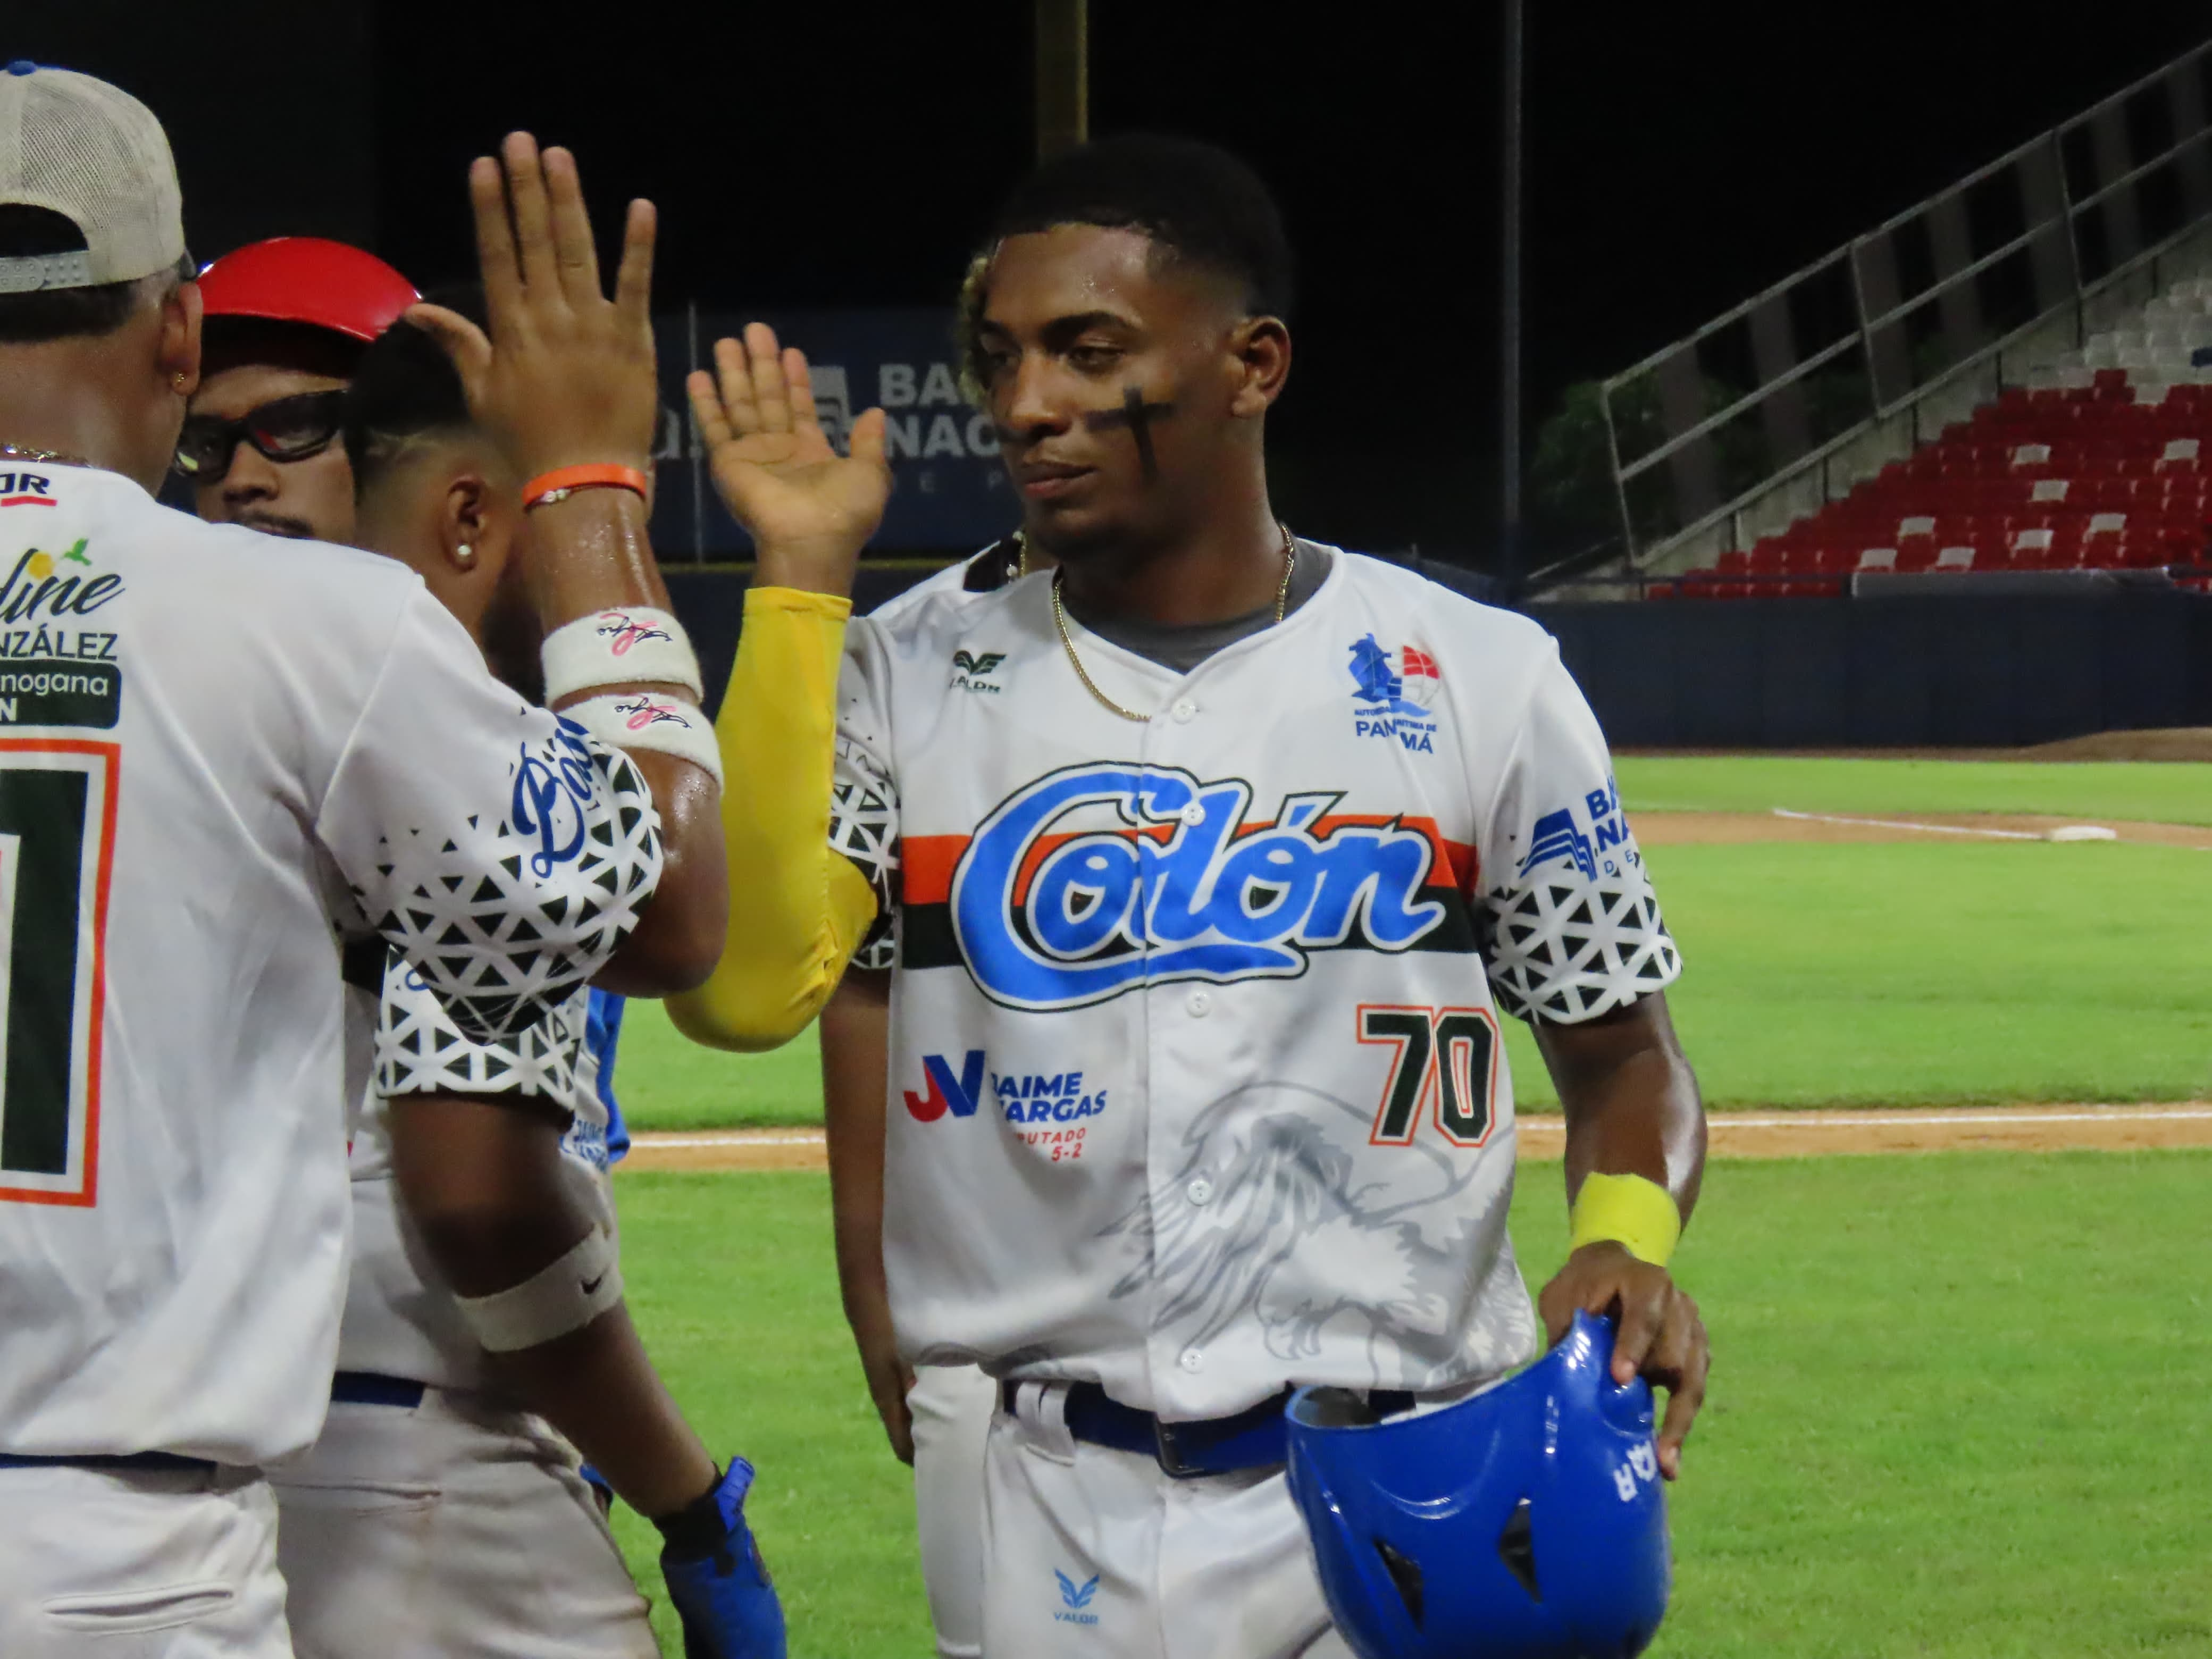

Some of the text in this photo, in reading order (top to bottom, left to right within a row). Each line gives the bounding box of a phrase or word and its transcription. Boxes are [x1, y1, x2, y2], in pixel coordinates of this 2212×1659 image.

[1355, 719, 1434, 755] PANMÁ
[950, 761, 1447, 1012] Colón
[904, 1050, 986, 1122] JV
[1356, 1005, 1498, 1147] 70
[999, 1090, 1108, 1123] ARGAS
[1052, 1143, 1082, 1162] 5-2
